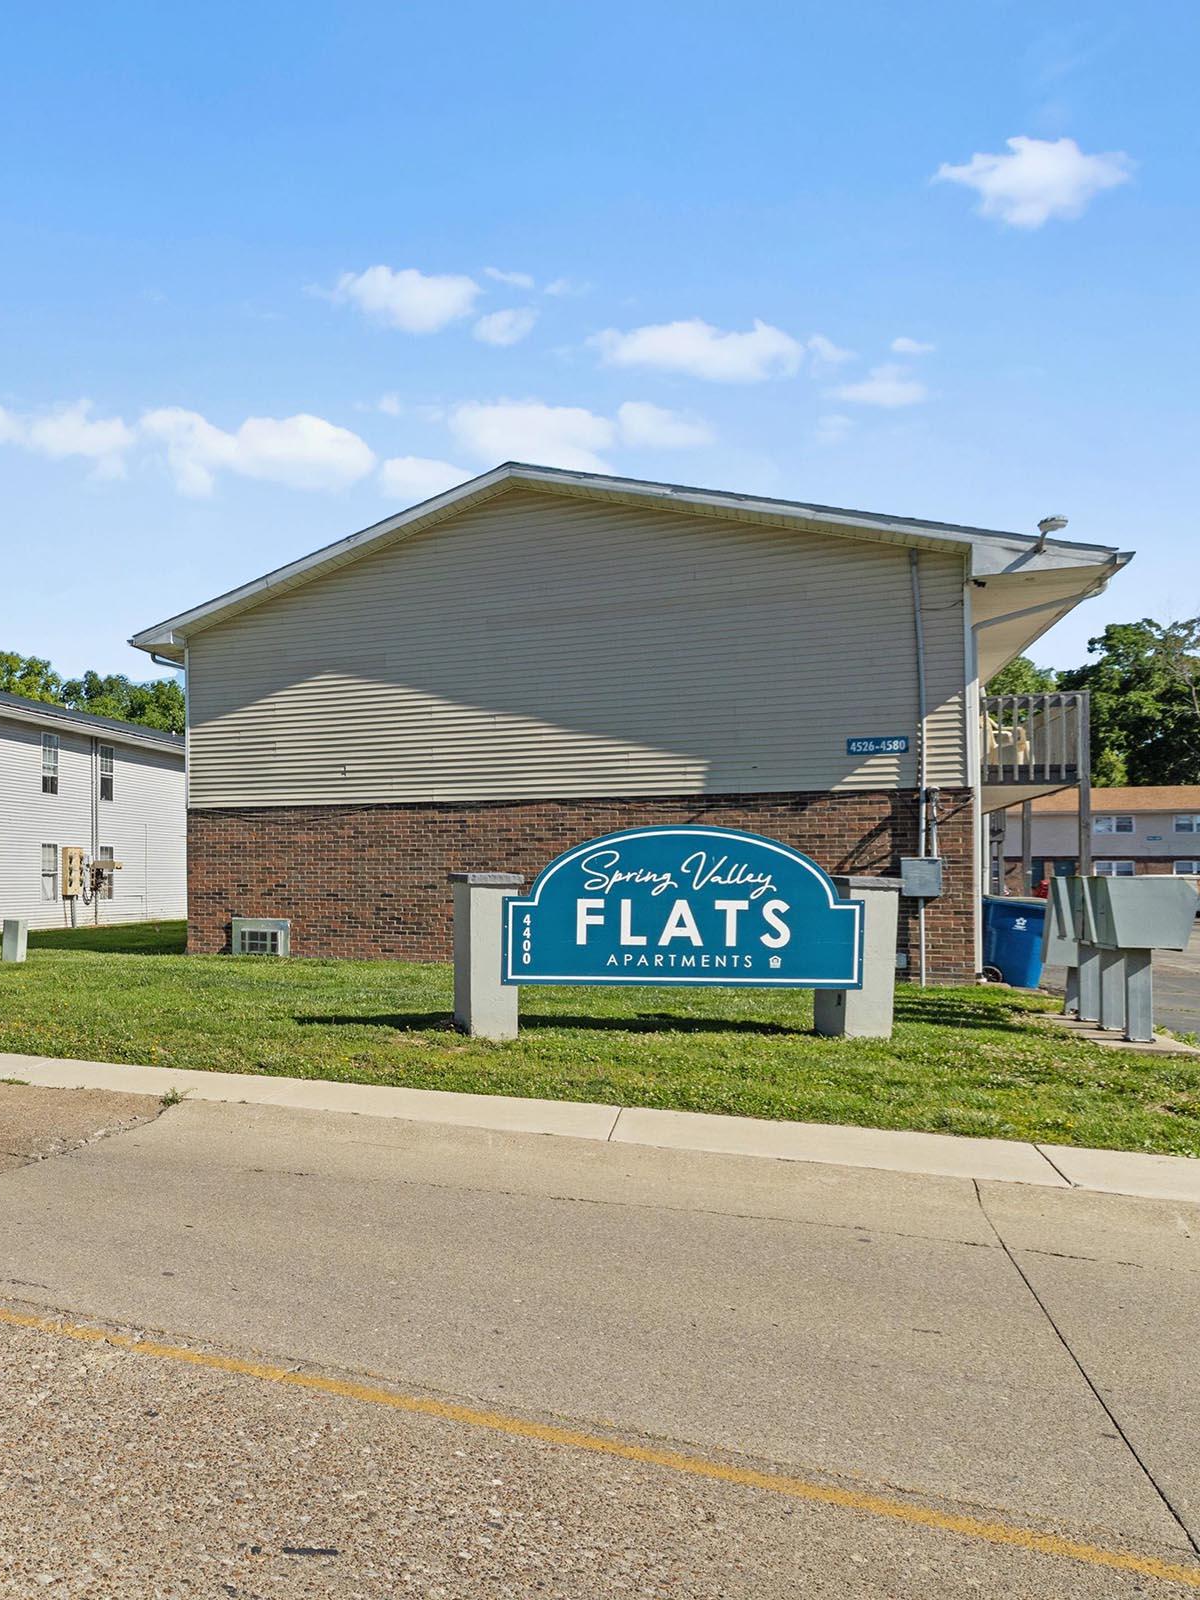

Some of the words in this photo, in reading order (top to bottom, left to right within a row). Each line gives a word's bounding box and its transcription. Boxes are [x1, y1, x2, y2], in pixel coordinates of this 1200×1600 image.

[850, 739, 906, 753] 4526-4580
[581, 850, 679, 897] Spring
[681, 851, 777, 900] Valley
[522, 913, 532, 965] 4400
[576, 898, 791, 949] FLATS
[605, 953, 753, 969] APARTMENTS
